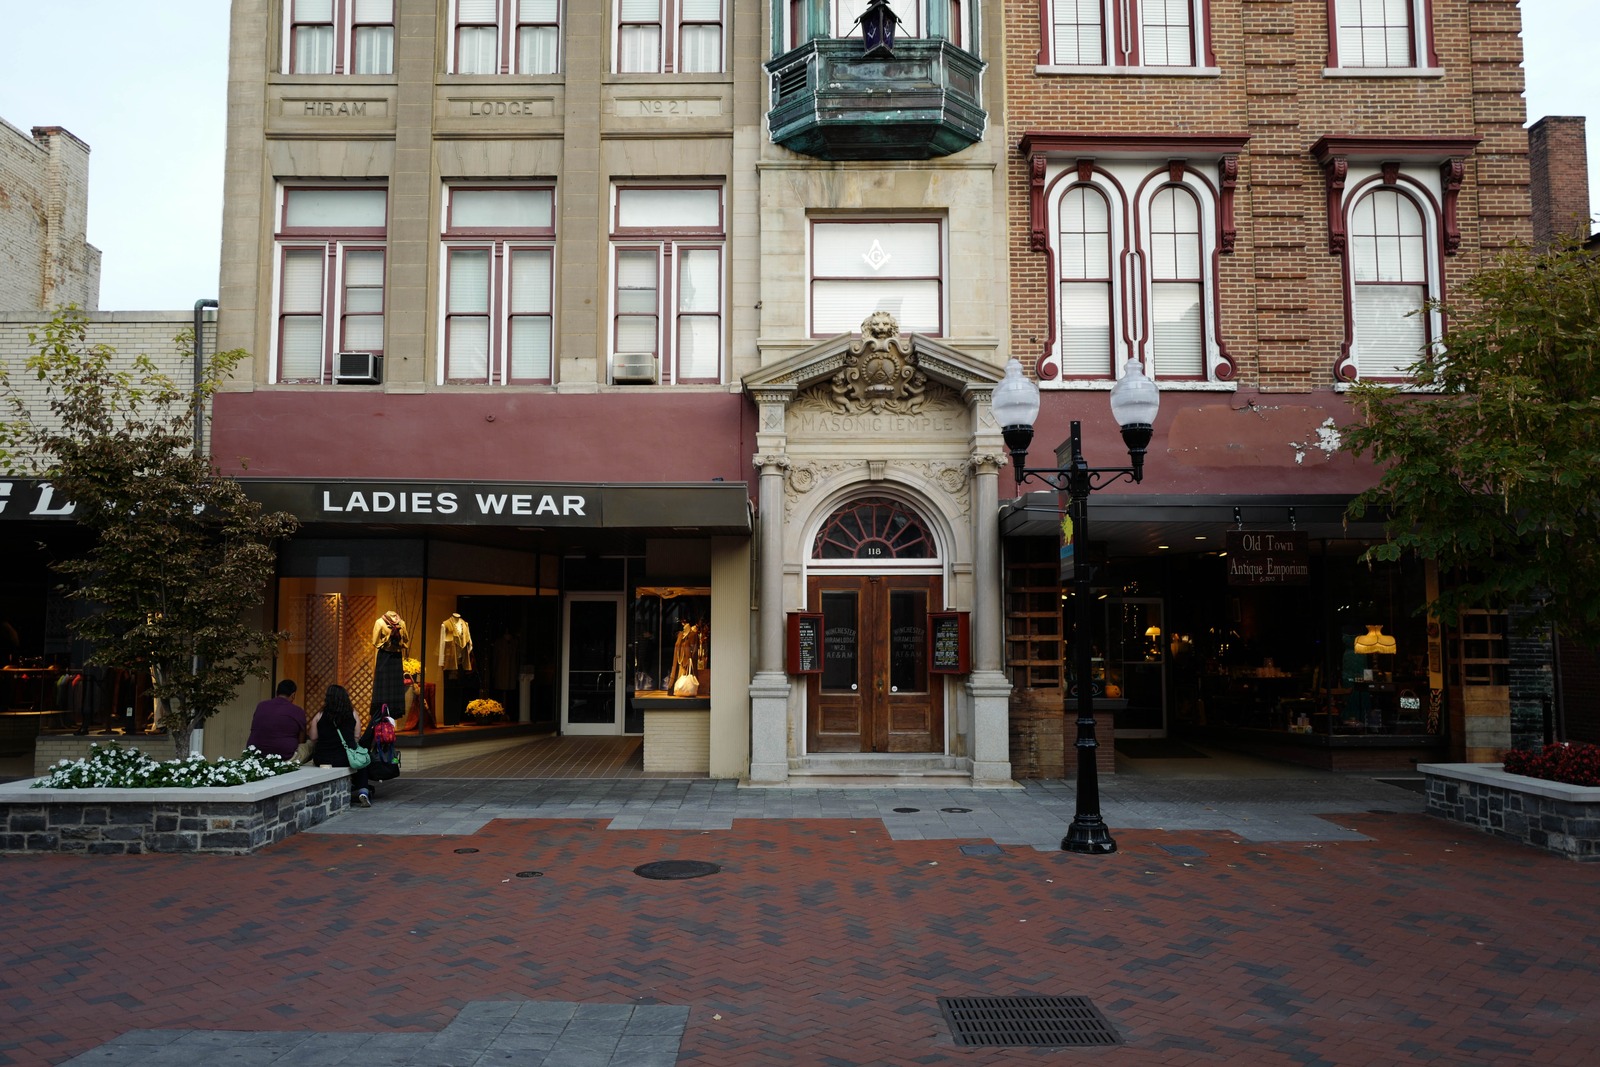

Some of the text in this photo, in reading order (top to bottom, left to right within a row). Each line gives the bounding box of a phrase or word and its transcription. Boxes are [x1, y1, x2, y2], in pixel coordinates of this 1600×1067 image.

[304, 101, 367, 117] HIRAM
[470, 101, 533, 116] LODGE
[801, 413, 953, 432] MASONIC TEMPLE
[323, 490, 586, 516] LADIES WEAR
[1242, 534, 1294, 551] Old Town
[1230, 557, 1308, 581] Antique Emporium
[825, 627, 856, 636] WINCHESTER
